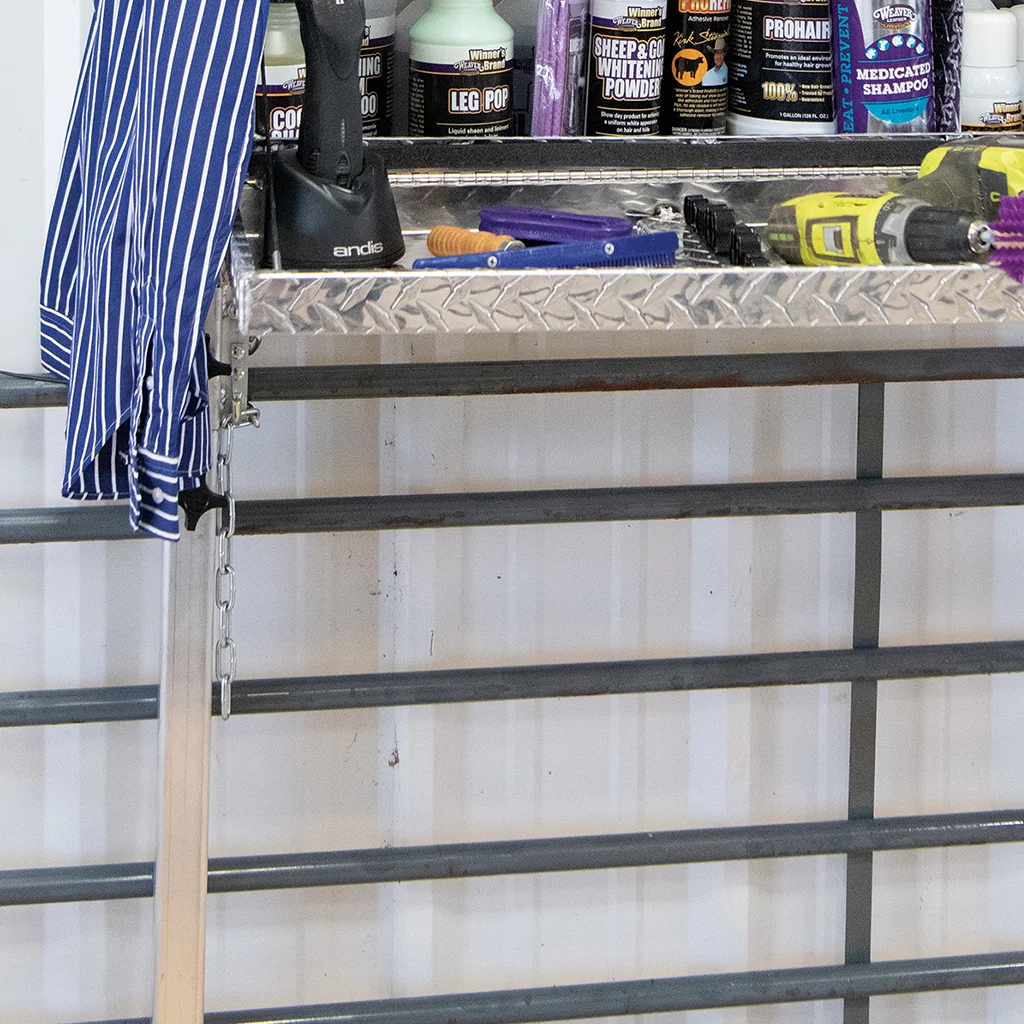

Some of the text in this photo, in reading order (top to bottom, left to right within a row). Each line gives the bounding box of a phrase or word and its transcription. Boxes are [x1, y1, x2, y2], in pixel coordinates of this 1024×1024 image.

[873, 4, 917, 23] WEAVER
[469, 47, 506, 61] Winner's
[594, 37, 637, 59] SHEEP
[637, 43, 648, 60] &
[837, 4, 853, 85] PREVENT
[483, 59, 506, 71] Brand
[765, 52, 789, 61] Promotes
[783, 61, 803, 69] healthy
[856, 61, 931, 81] MEDICATED
[605, 78, 661, 98] POWDER
[762, 81, 798, 102] 100%
[863, 77, 929, 96] SHAMPOO
[451, 87, 508, 112] LEG POP
[448, 127, 467, 135] Liquid
[333, 240, 384, 257] andis
